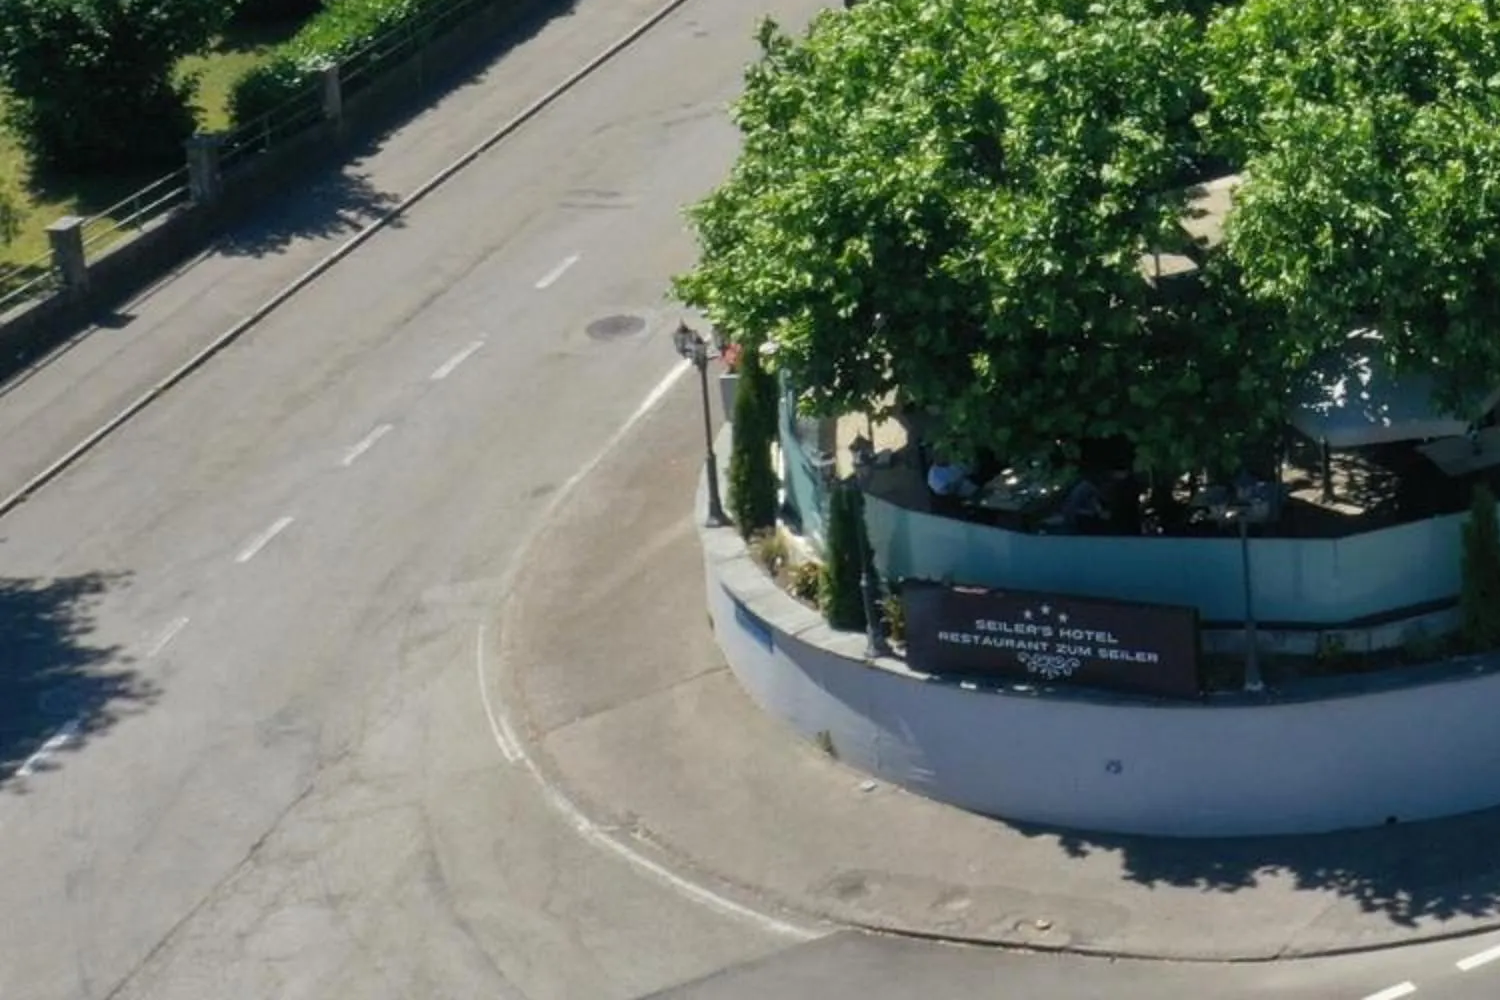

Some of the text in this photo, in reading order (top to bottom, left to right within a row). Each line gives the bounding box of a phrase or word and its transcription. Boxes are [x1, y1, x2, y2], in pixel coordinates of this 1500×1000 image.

[975, 618, 1119, 644] SEILER'S HOTEL
[938, 631, 1159, 664] RESTAURANT ZUM SEILER
